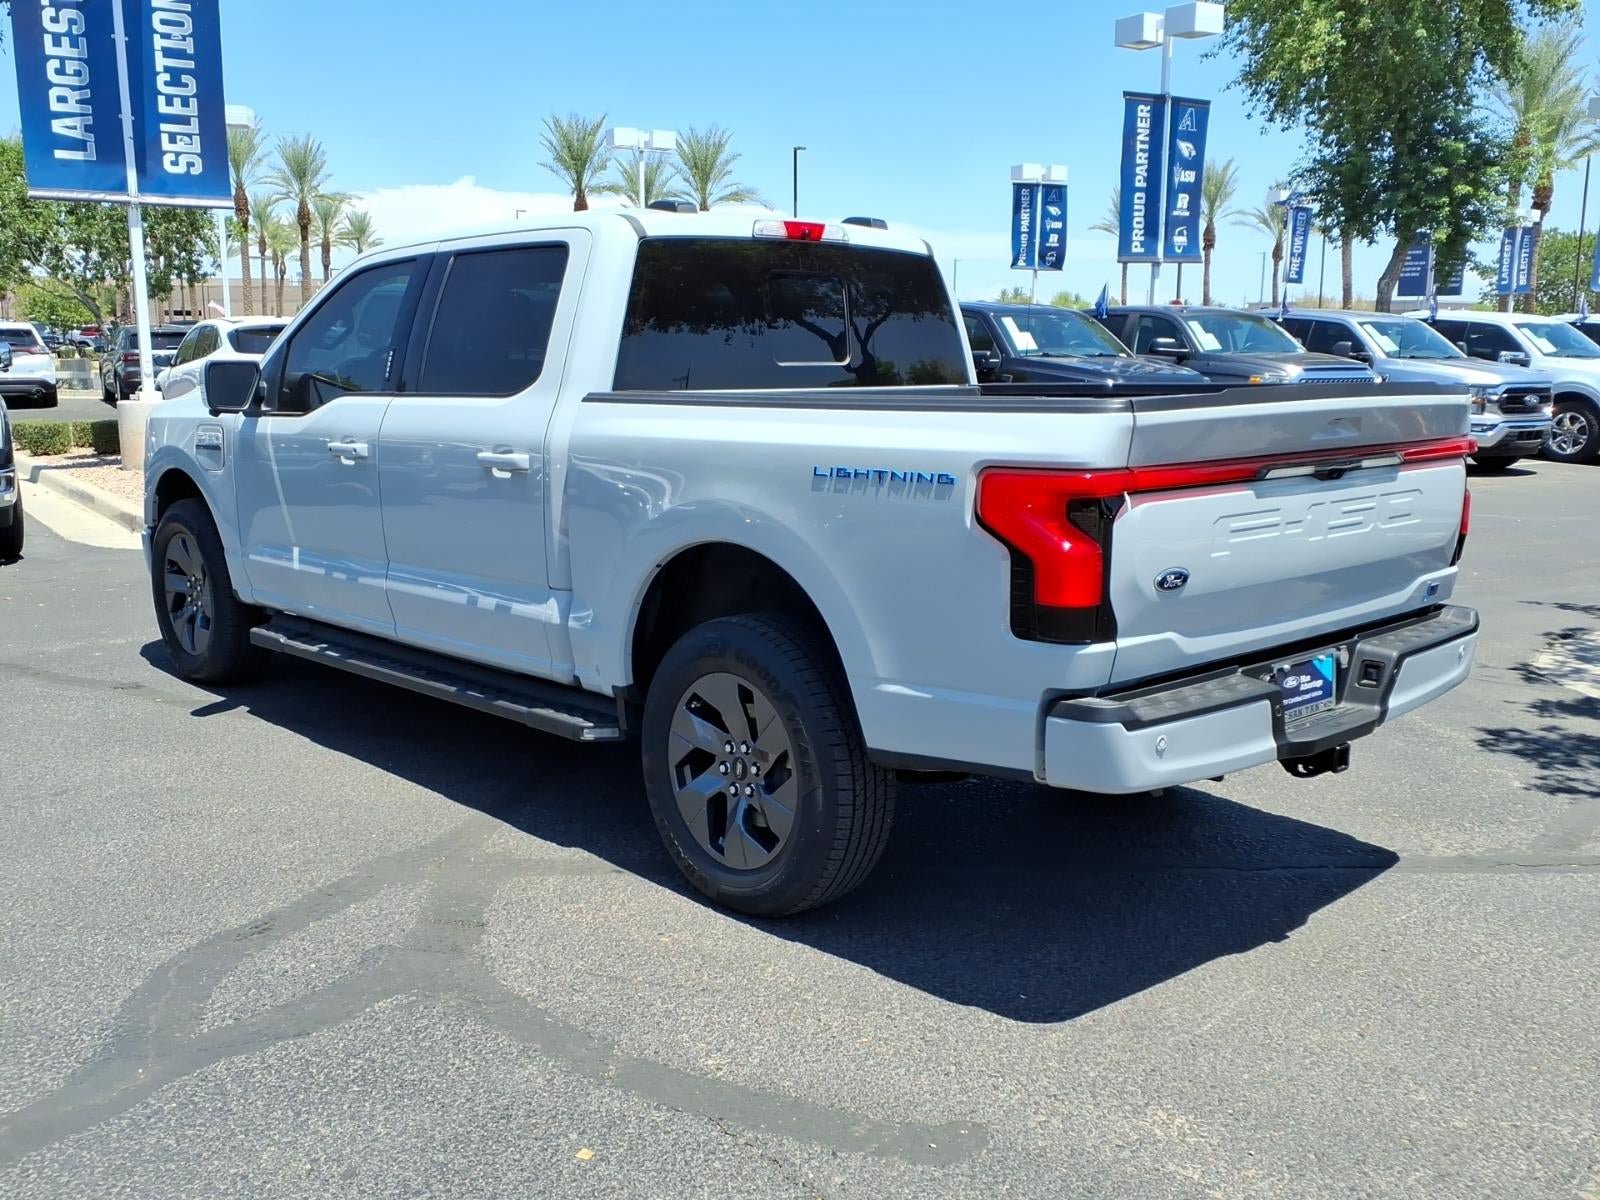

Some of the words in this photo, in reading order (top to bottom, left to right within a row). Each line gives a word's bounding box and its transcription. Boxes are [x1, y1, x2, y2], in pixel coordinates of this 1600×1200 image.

[41, 0, 97, 161] LARGES
[1134, 104, 1151, 187] PARTNER
[1179, 170, 1196, 183] ASU
[1020, 188, 1030, 232] PARTNER
[1131, 191, 1147, 253] PROUD
[1018, 234, 1029, 266] PROUD
[1289, 212, 1307, 279] PRE-OWNED
[1519, 235, 1531, 285] SELECTION
[812, 466, 955, 485] LIGHTNING
